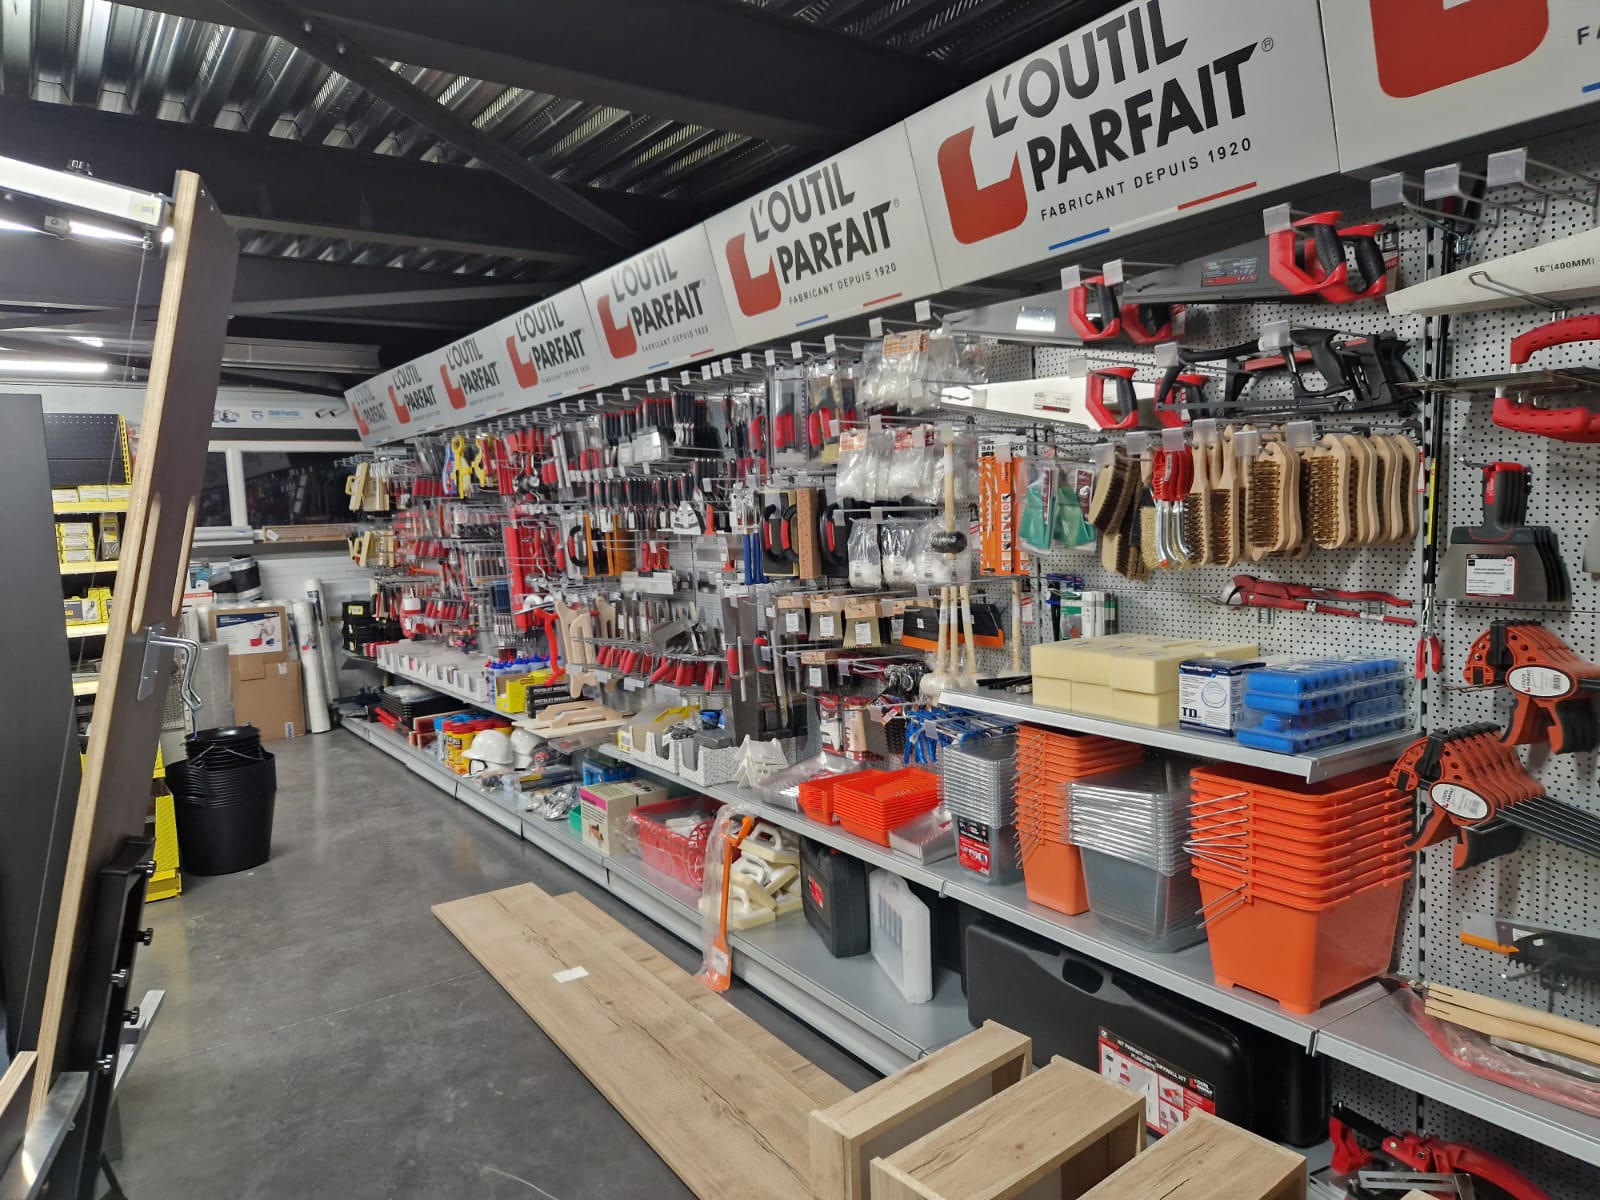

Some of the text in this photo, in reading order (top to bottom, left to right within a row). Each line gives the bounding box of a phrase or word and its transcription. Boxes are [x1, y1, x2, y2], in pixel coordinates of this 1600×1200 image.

[985, 1, 1188, 138] L'OUTIL
[1027, 42, 1258, 192] PARFAIT
[750, 161, 856, 243] L'OUTIL
[1041, 138, 1252, 221] FABRICANT DEPUIS 1920
[776, 200, 892, 285] PARFAIT
[610, 247, 678, 303] L'OUTIL
[788, 262, 897, 305] FABRICANT DEPUIS 1920
[515, 301, 565, 343] L'OUTIL
[630, 280, 704, 337] PARFAIT
[446, 337, 484, 371] L'OUTIL
[531, 328, 585, 372] PARFAIT
[403, 384, 438, 413] PARFAIT
[459, 361, 501, 396] PARFAIT
[1181, 707, 1198, 718] TD
